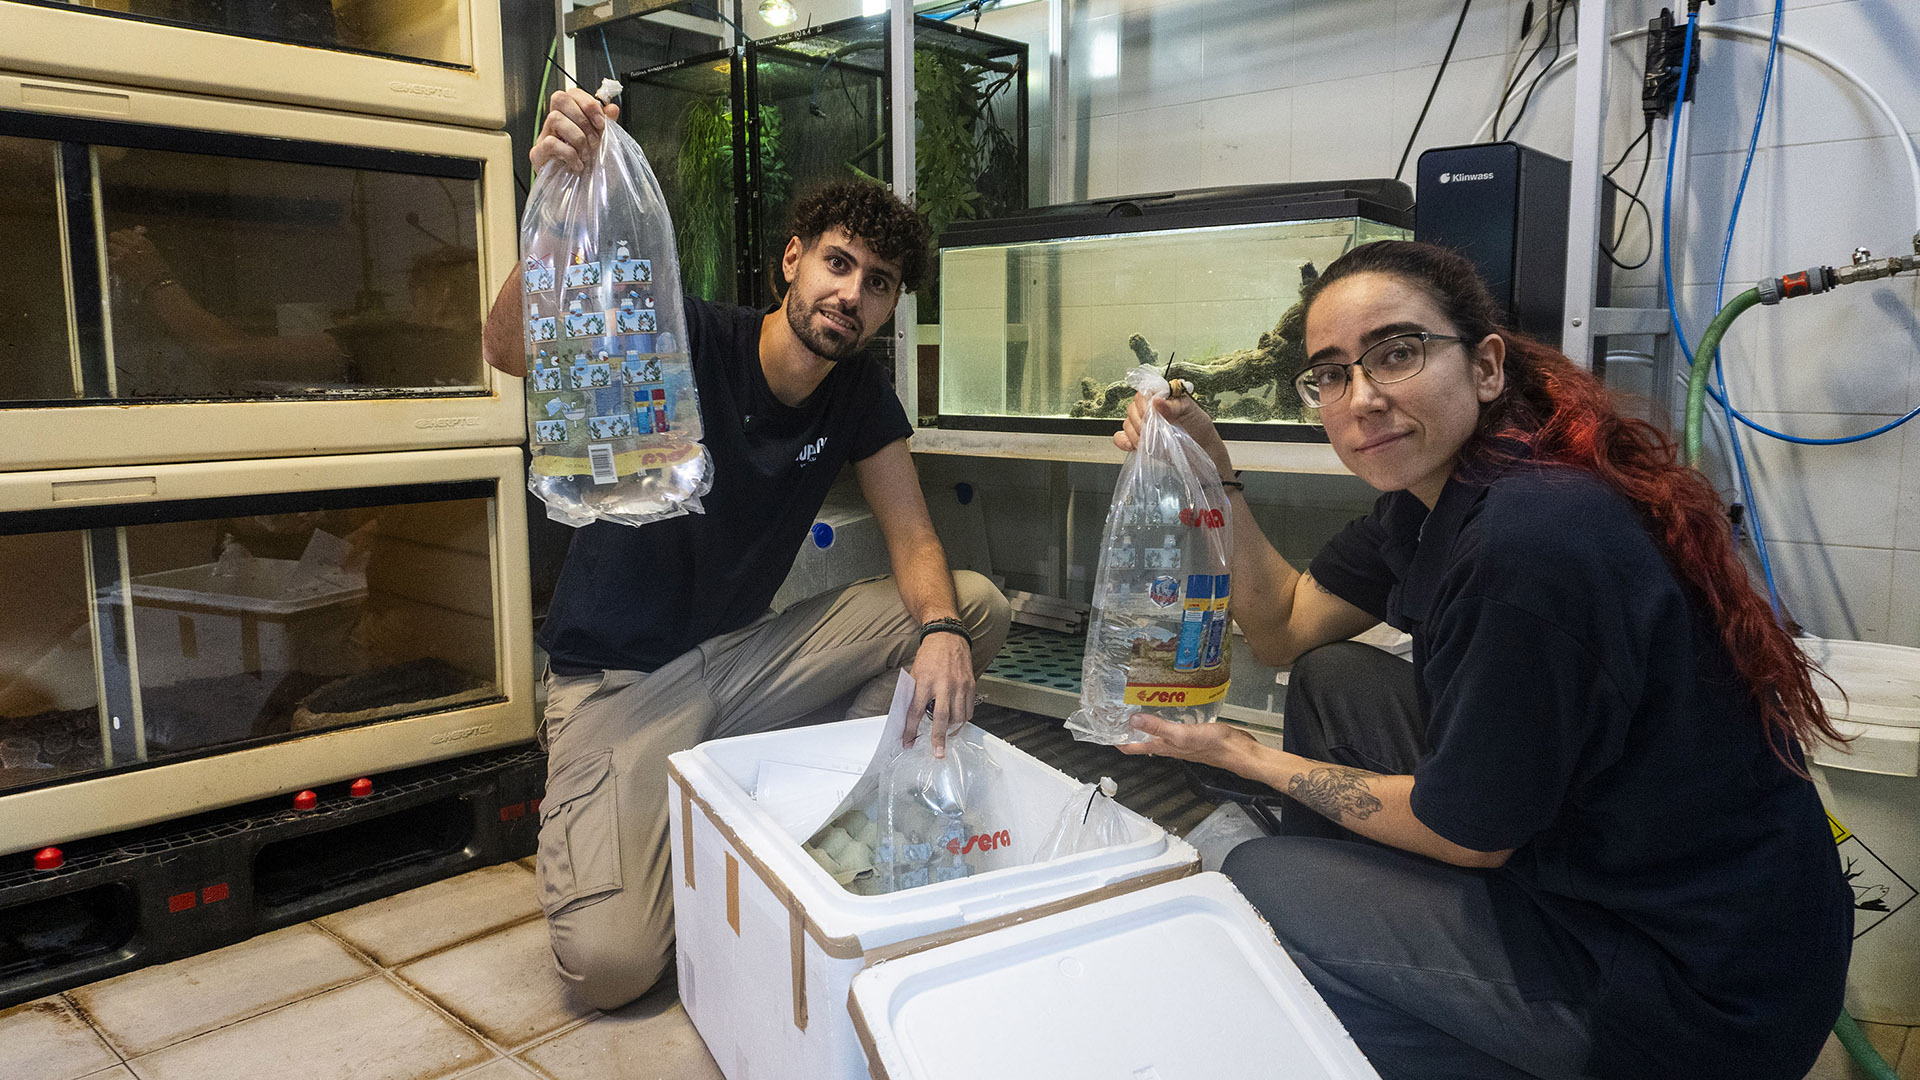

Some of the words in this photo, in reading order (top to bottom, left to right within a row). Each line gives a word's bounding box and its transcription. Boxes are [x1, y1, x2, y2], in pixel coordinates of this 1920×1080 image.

[1452, 172, 1494, 183] Klinwass
[1146, 691, 1186, 703] sera
[961, 829, 1011, 855] sera
